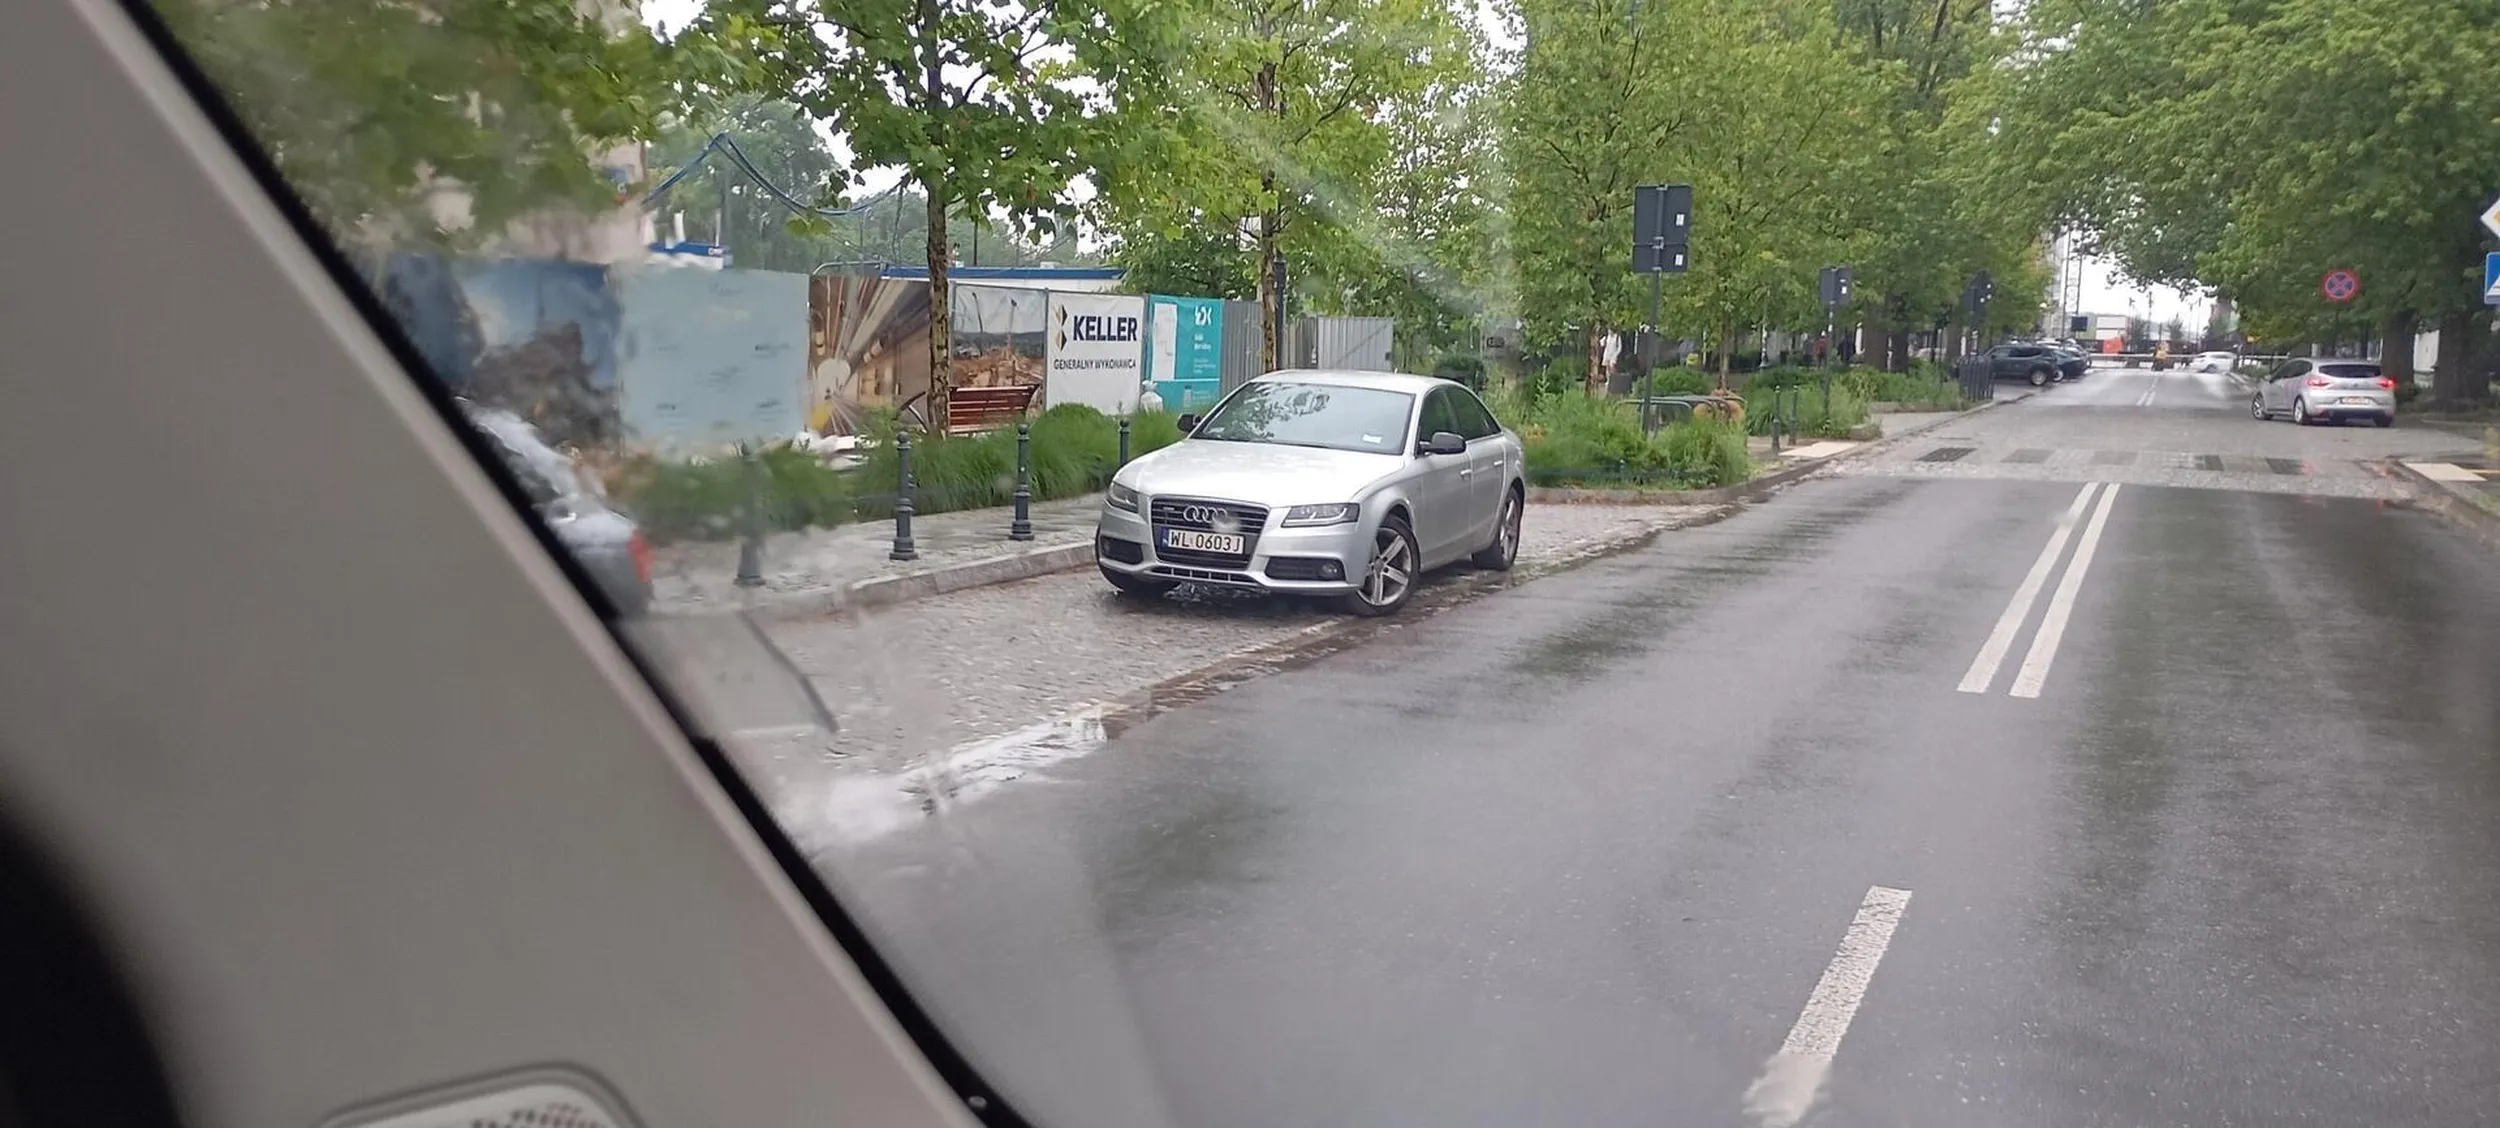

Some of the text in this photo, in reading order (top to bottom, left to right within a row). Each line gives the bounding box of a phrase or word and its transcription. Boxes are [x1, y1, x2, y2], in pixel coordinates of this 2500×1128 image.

[1073, 315, 1137, 341] KELLER
[1054, 358, 1136, 370] GENERALNY WYKONAWCA
[1171, 531, 1190, 547] WL
[1196, 533, 1240, 552] 0603J
